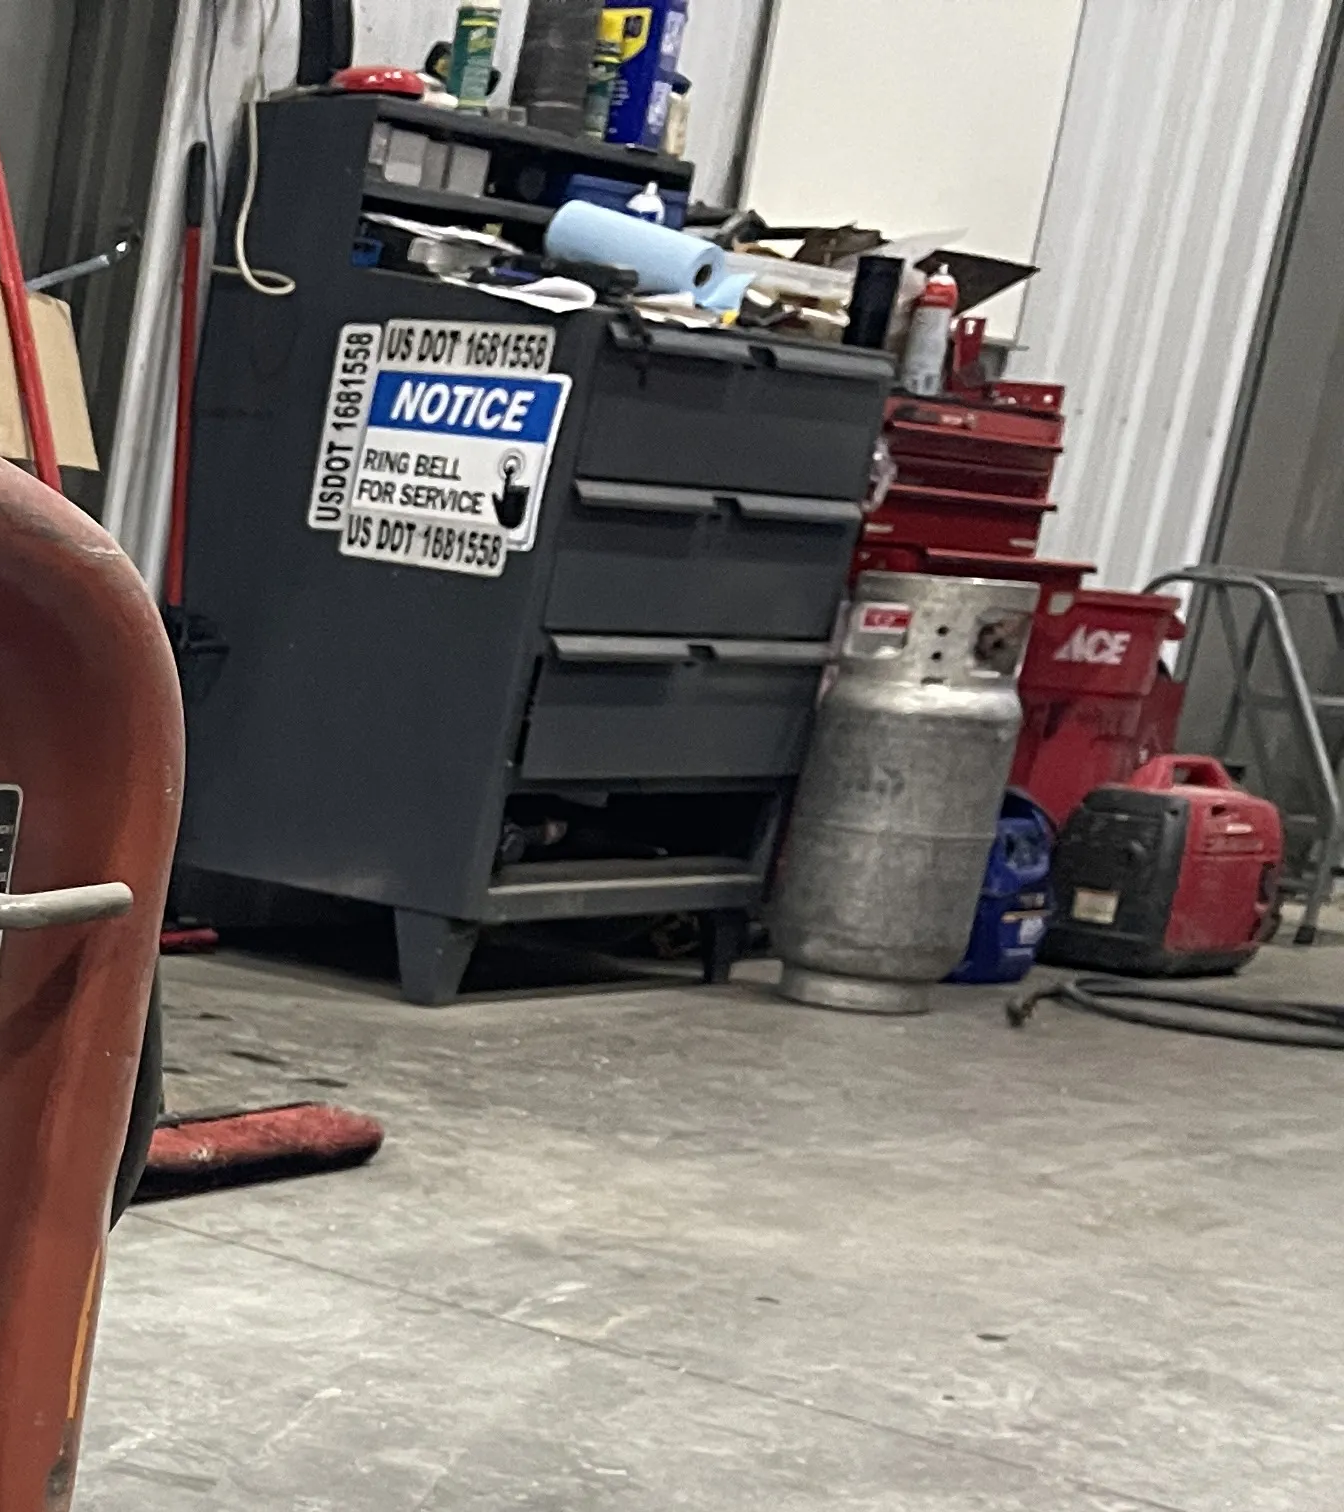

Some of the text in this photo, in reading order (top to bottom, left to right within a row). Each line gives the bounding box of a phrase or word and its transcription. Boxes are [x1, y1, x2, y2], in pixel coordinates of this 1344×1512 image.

[385, 327, 548, 369] US DOT 1681558
[315, 331, 373, 522] USDOT 1681558
[389, 380, 536, 432] NOTICE
[363, 448, 462, 481] RING BELL
[357, 478, 487, 515] FOR SERVICE
[346, 514, 503, 569] US DOT 1681558
[1053, 623, 1132, 666] ACE
